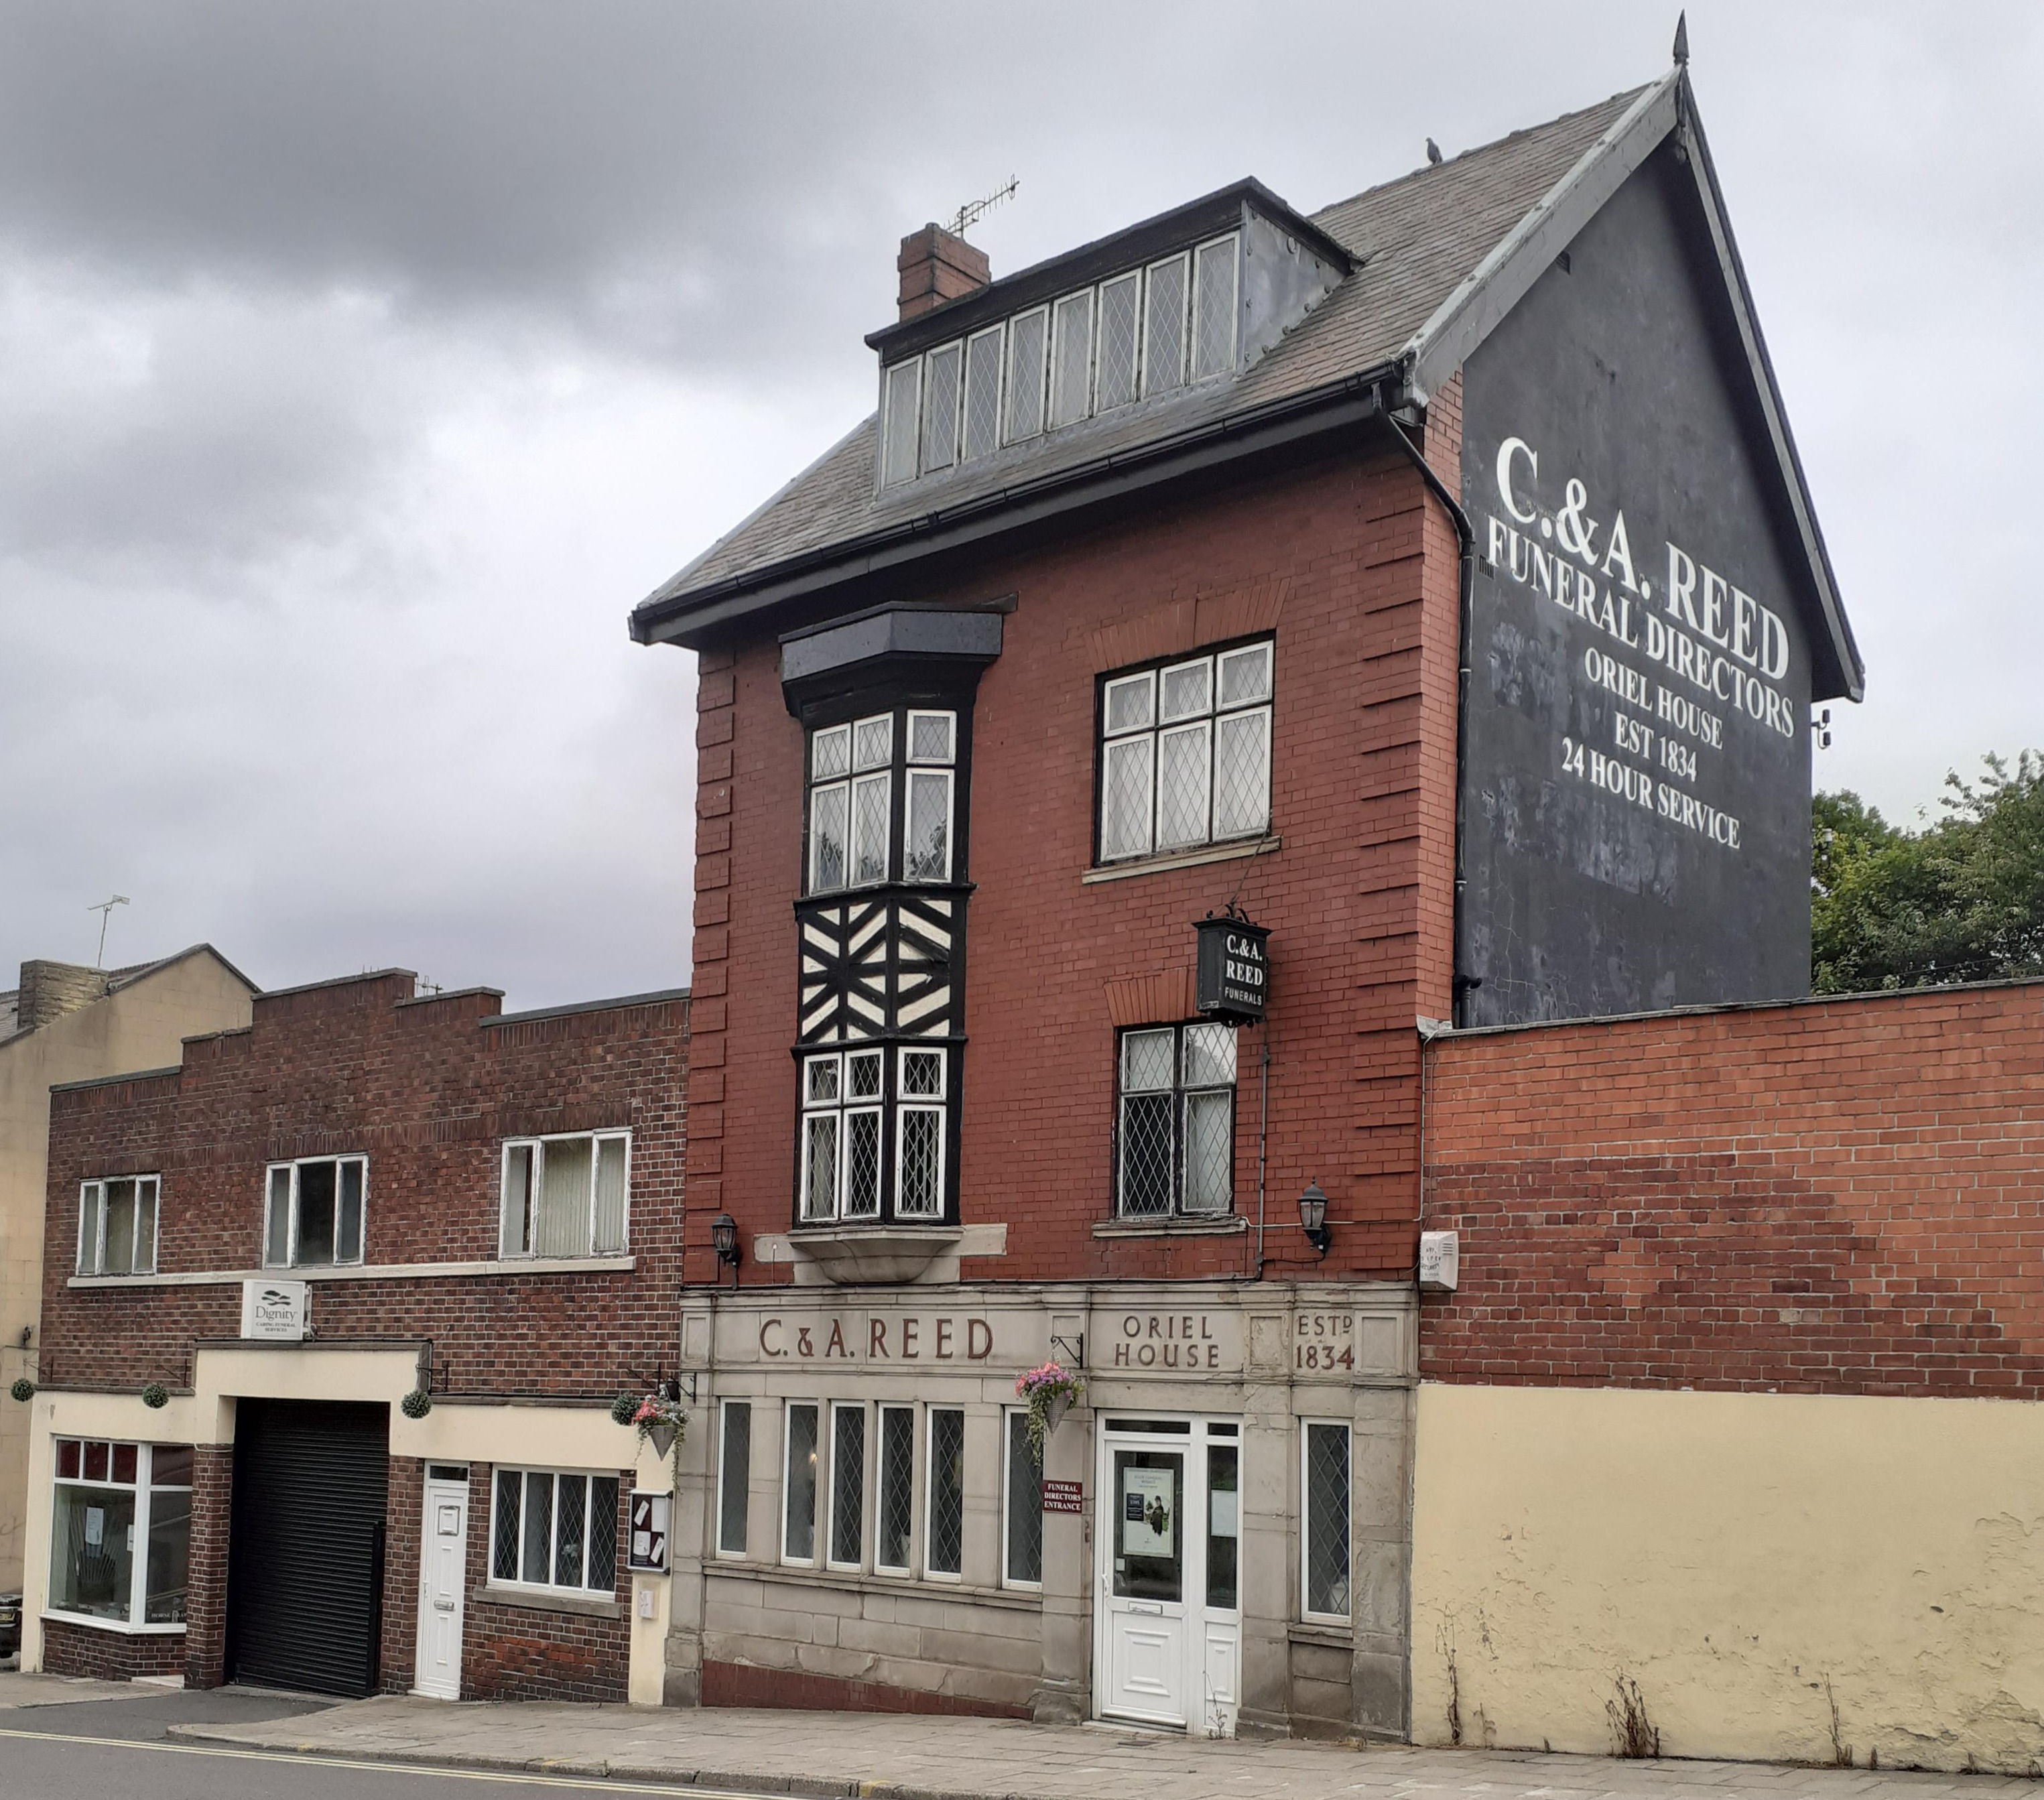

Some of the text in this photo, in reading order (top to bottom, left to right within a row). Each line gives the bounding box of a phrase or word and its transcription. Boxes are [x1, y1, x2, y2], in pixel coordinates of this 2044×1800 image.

[1665, 541, 1789, 680] REED
[1487, 515, 1794, 738] FUNERAL DIRECTORS
[1584, 647, 1723, 750] ORIEL HOUSE
[1614, 711, 1696, 782] EST 1834
[1562, 737, 1741, 850] 24 HOUR SERVICE
[1226, 959, 1263, 986] REED
[1224, 986, 1262, 1006] FUNERALS
[255, 1305, 296, 1322] Dignity
[869, 1318, 993, 1359] REED
[1123, 1315, 1213, 1339] ORIEL
[1114, 1343, 1219, 1368] HOUSE
[1295, 1344, 1355, 1370] 1834
[1044, 1492, 1081, 1501] DIRECTORS
[1047, 1483, 1078, 1492] FUNERAL
[1044, 1500, 1081, 1510] ENTRANCE
